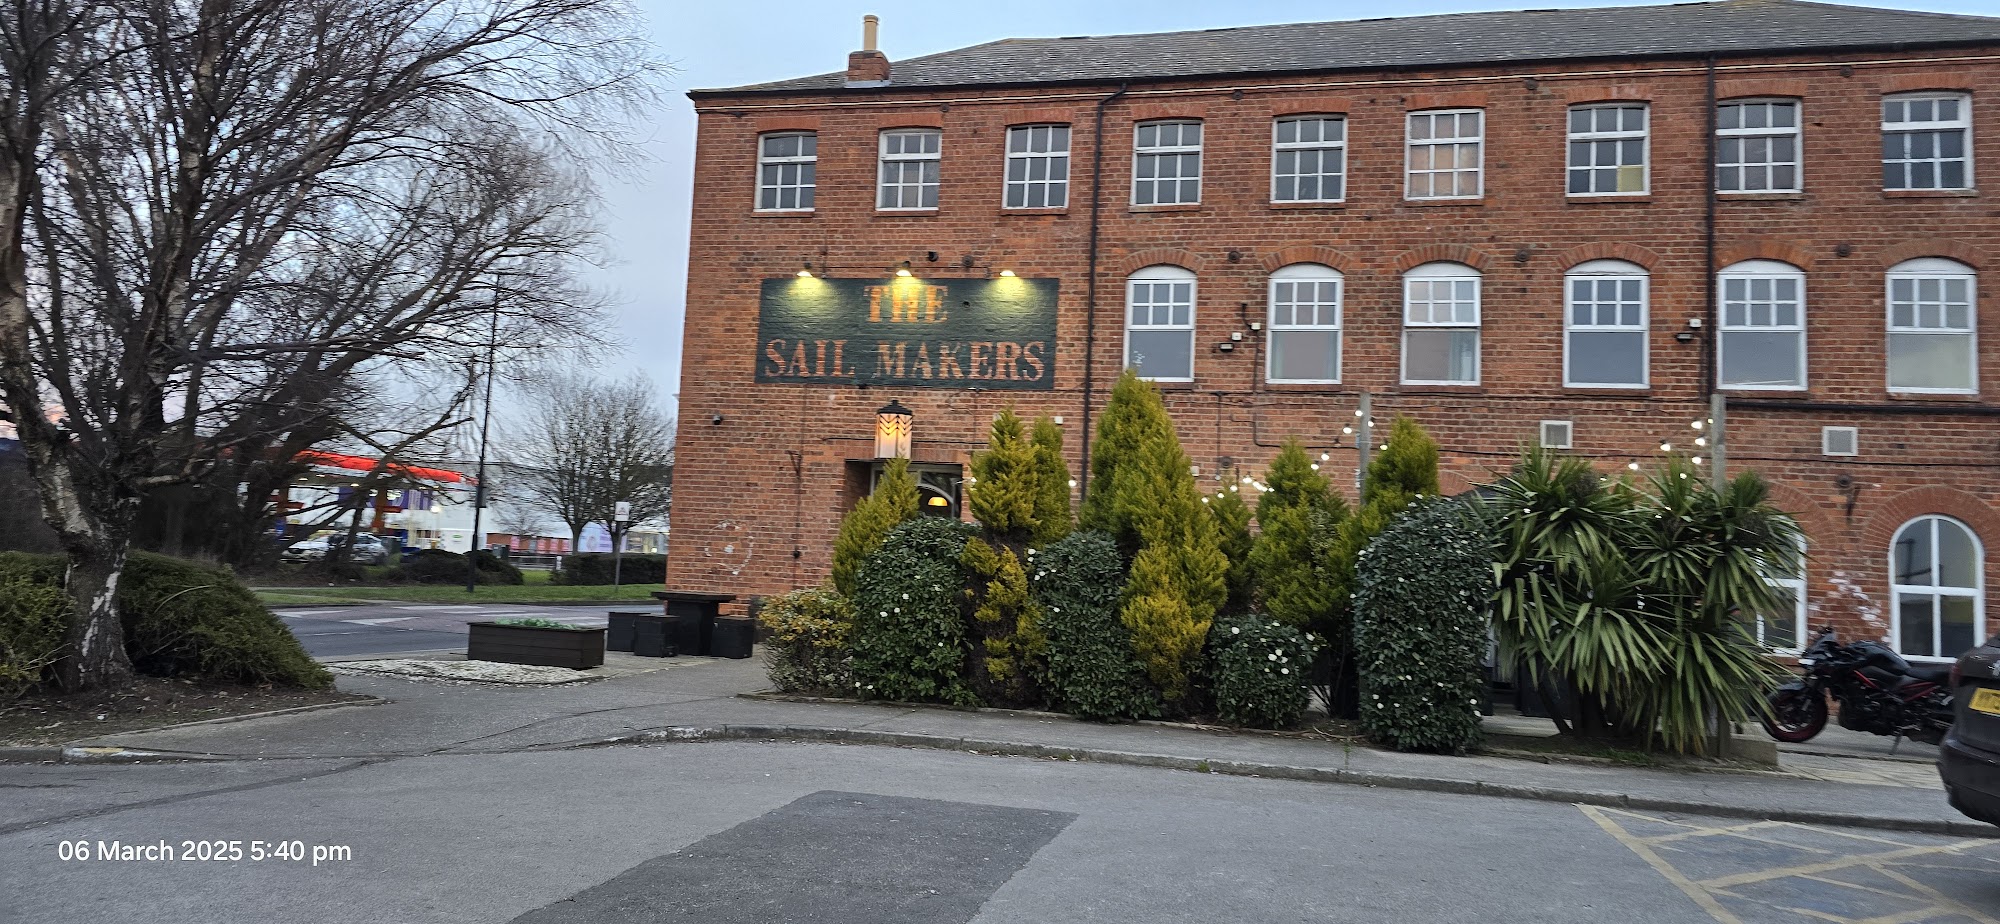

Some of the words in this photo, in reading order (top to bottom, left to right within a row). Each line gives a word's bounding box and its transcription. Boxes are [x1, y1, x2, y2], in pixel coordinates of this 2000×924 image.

[864, 284, 948, 323] THE
[764, 338, 855, 378] SAIL
[872, 340, 1046, 382] MAKERS
